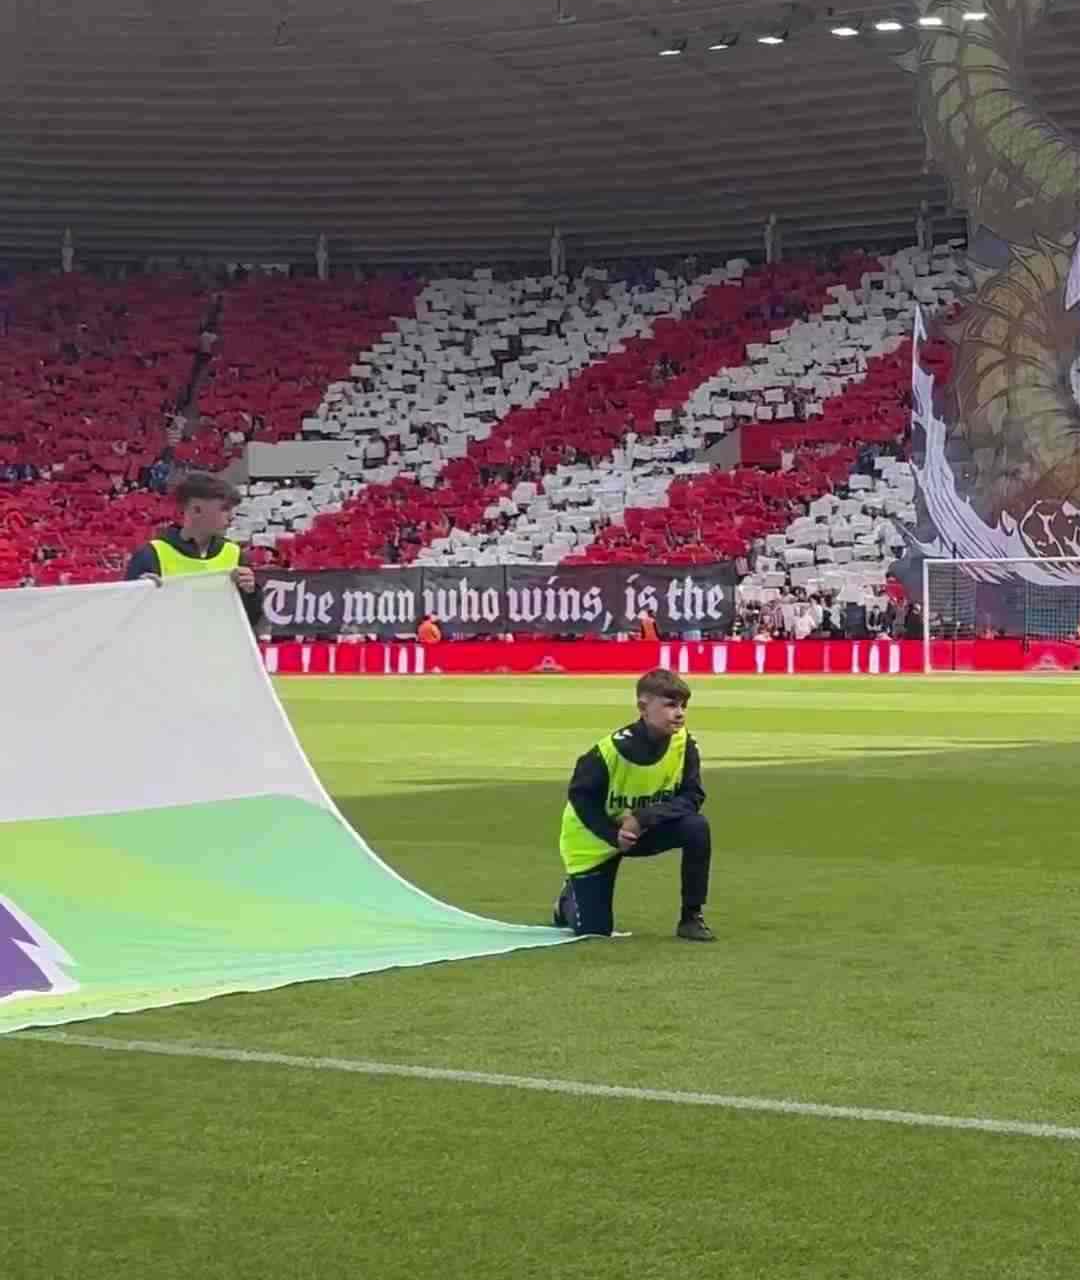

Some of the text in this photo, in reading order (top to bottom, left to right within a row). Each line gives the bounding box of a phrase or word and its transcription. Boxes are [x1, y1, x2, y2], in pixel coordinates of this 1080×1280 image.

[262, 573, 725, 632] The man who wins, is the
